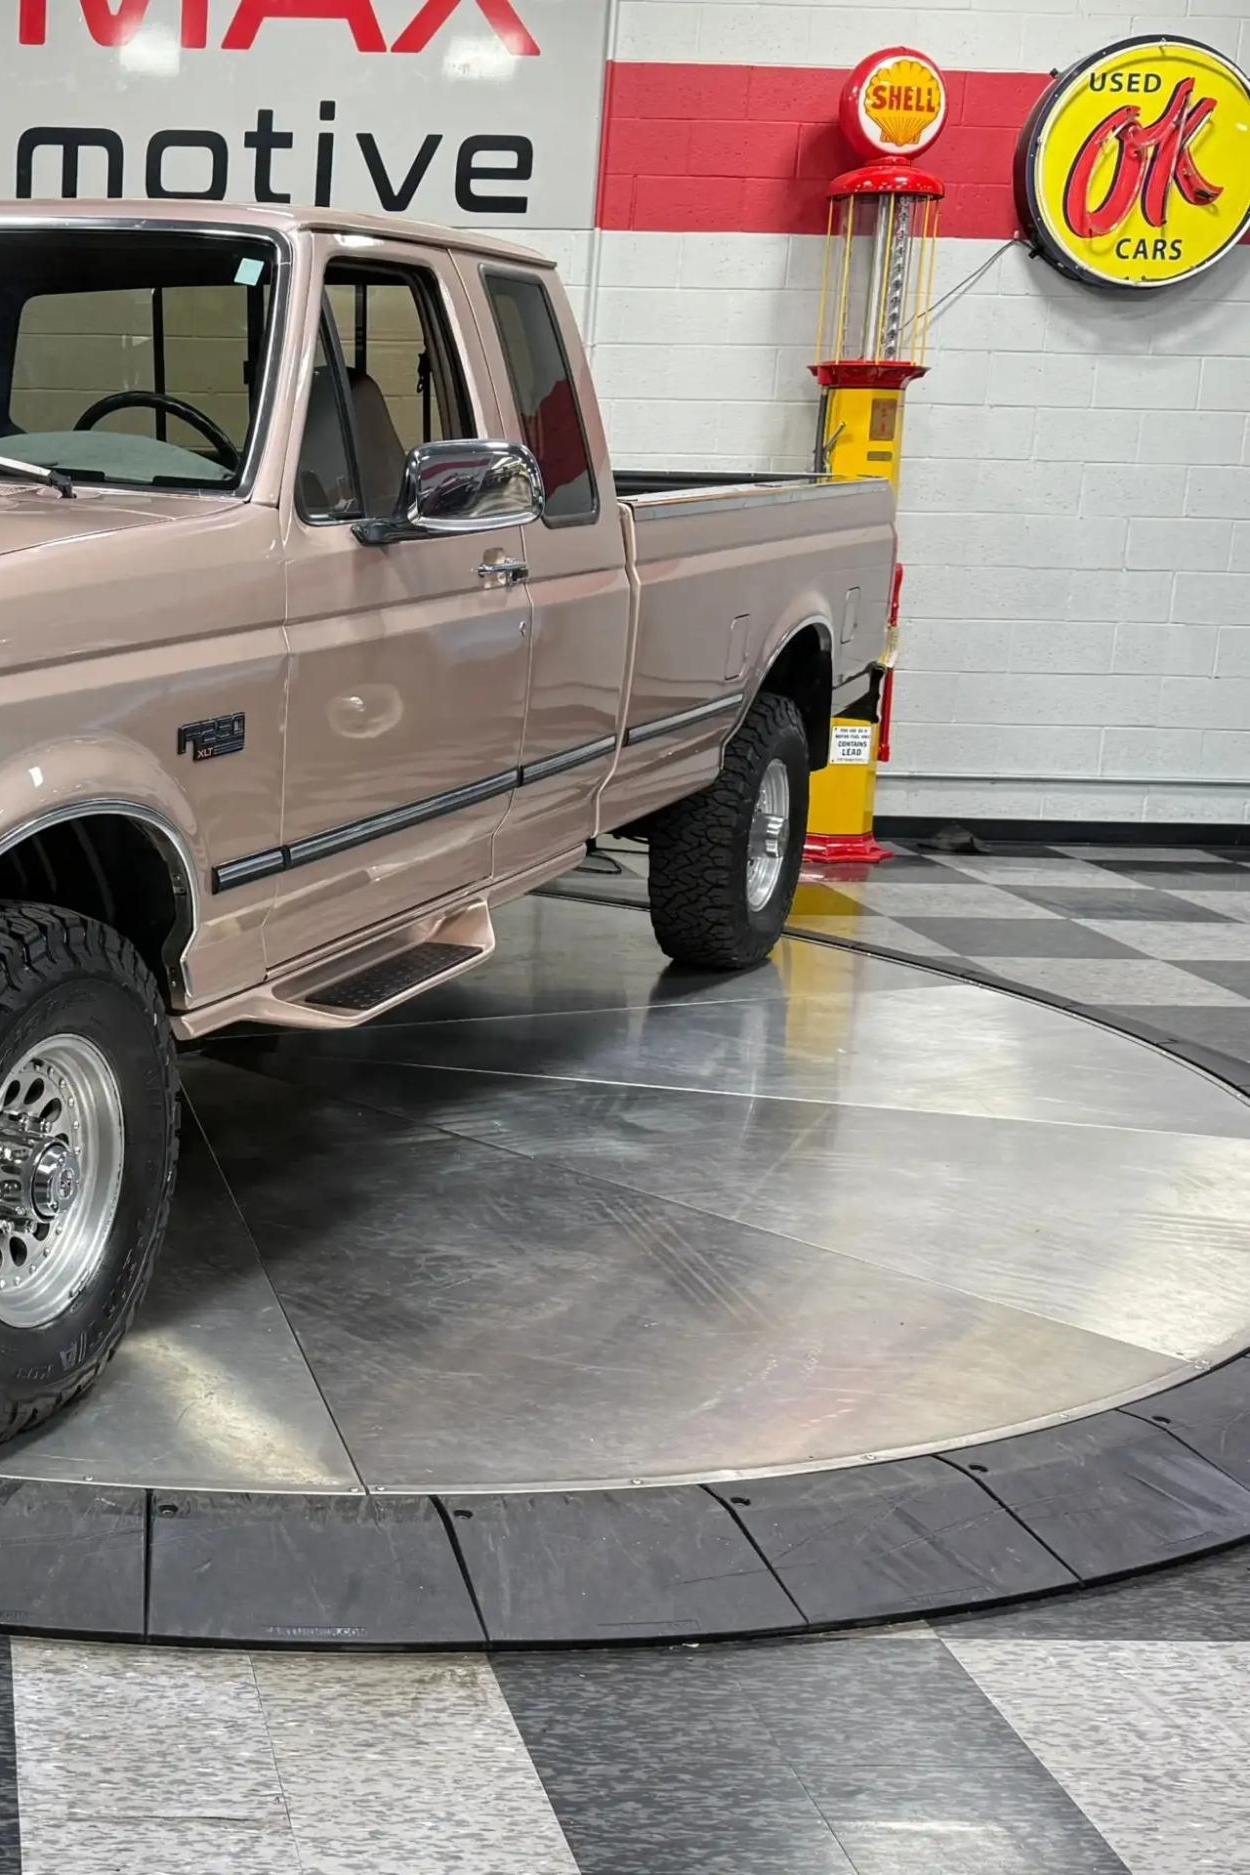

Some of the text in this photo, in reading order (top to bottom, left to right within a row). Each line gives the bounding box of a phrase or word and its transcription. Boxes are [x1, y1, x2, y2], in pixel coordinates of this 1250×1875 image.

[1089, 72, 1162, 93] USED
[871, 85, 936, 113] SHELL
[16, 100, 534, 214] motive
[1115, 238, 1183, 260] CARS
[197, 747, 214, 759] XLT
[842, 748, 861, 756] LEAD
